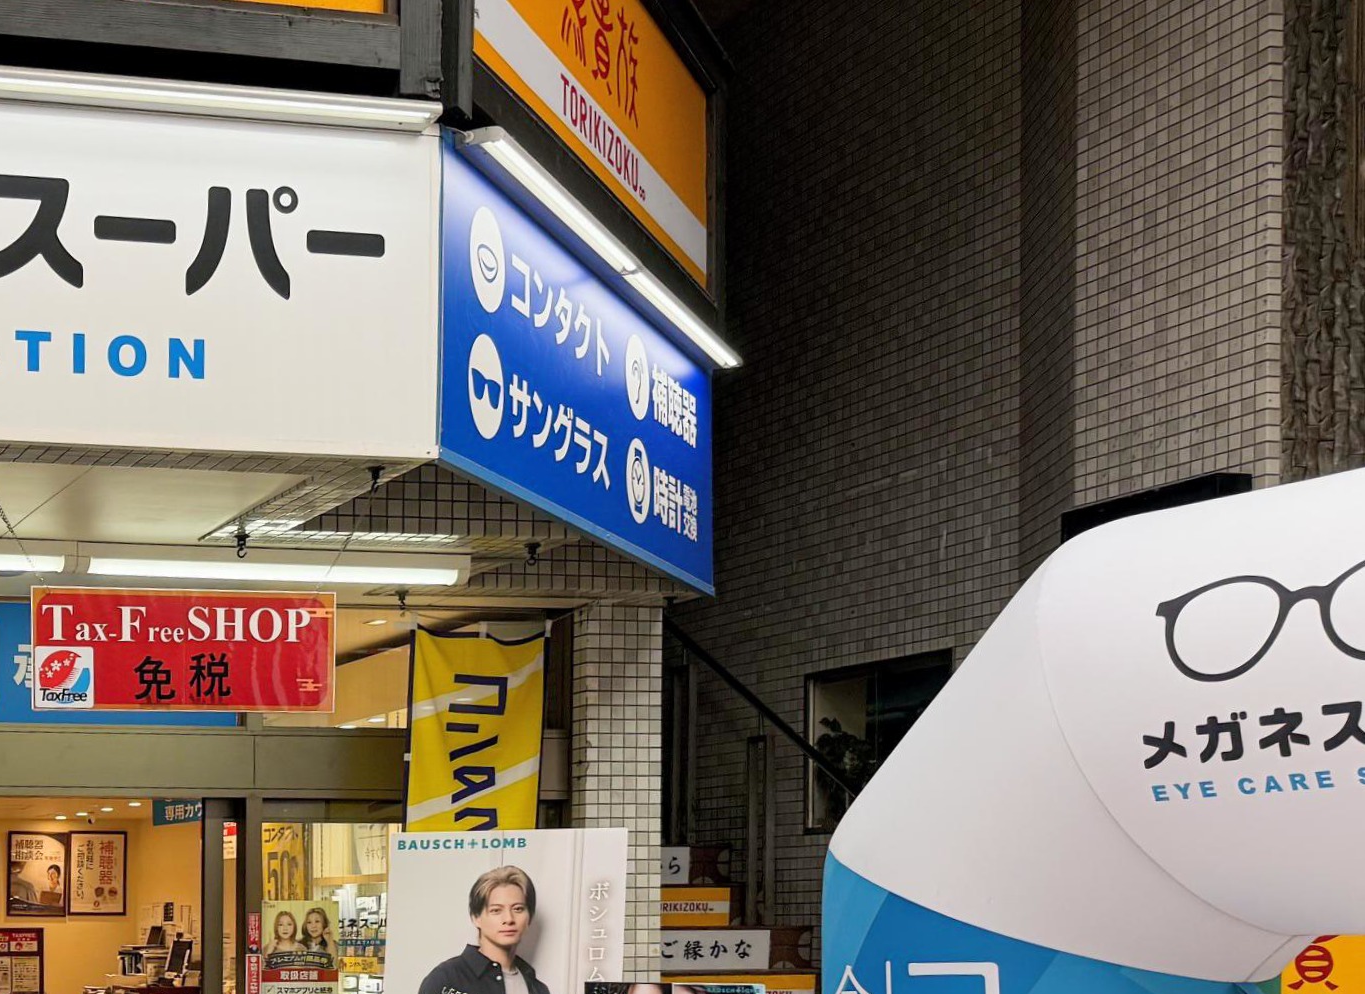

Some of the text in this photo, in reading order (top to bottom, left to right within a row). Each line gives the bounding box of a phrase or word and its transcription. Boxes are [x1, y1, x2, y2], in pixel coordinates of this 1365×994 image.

[560, 73, 640, 193] TORIKIZOKU
[511, 253, 610, 376] コンタクト
[509, 373, 611, 490] サングラス
[651, 363, 697, 448] 補聴器
[653, 466, 682, 531] 時計
[187, 606, 311, 643] SHOP
[134, 653, 231, 700] 免税
[1142, 700, 1365, 770] メガネス
[1151, 781, 1217, 801] EYE
[1237, 770, 1334, 794] CARE
[587, 881, 610, 981] ボシュロム
[661, 940, 752, 960] ご縁かな
